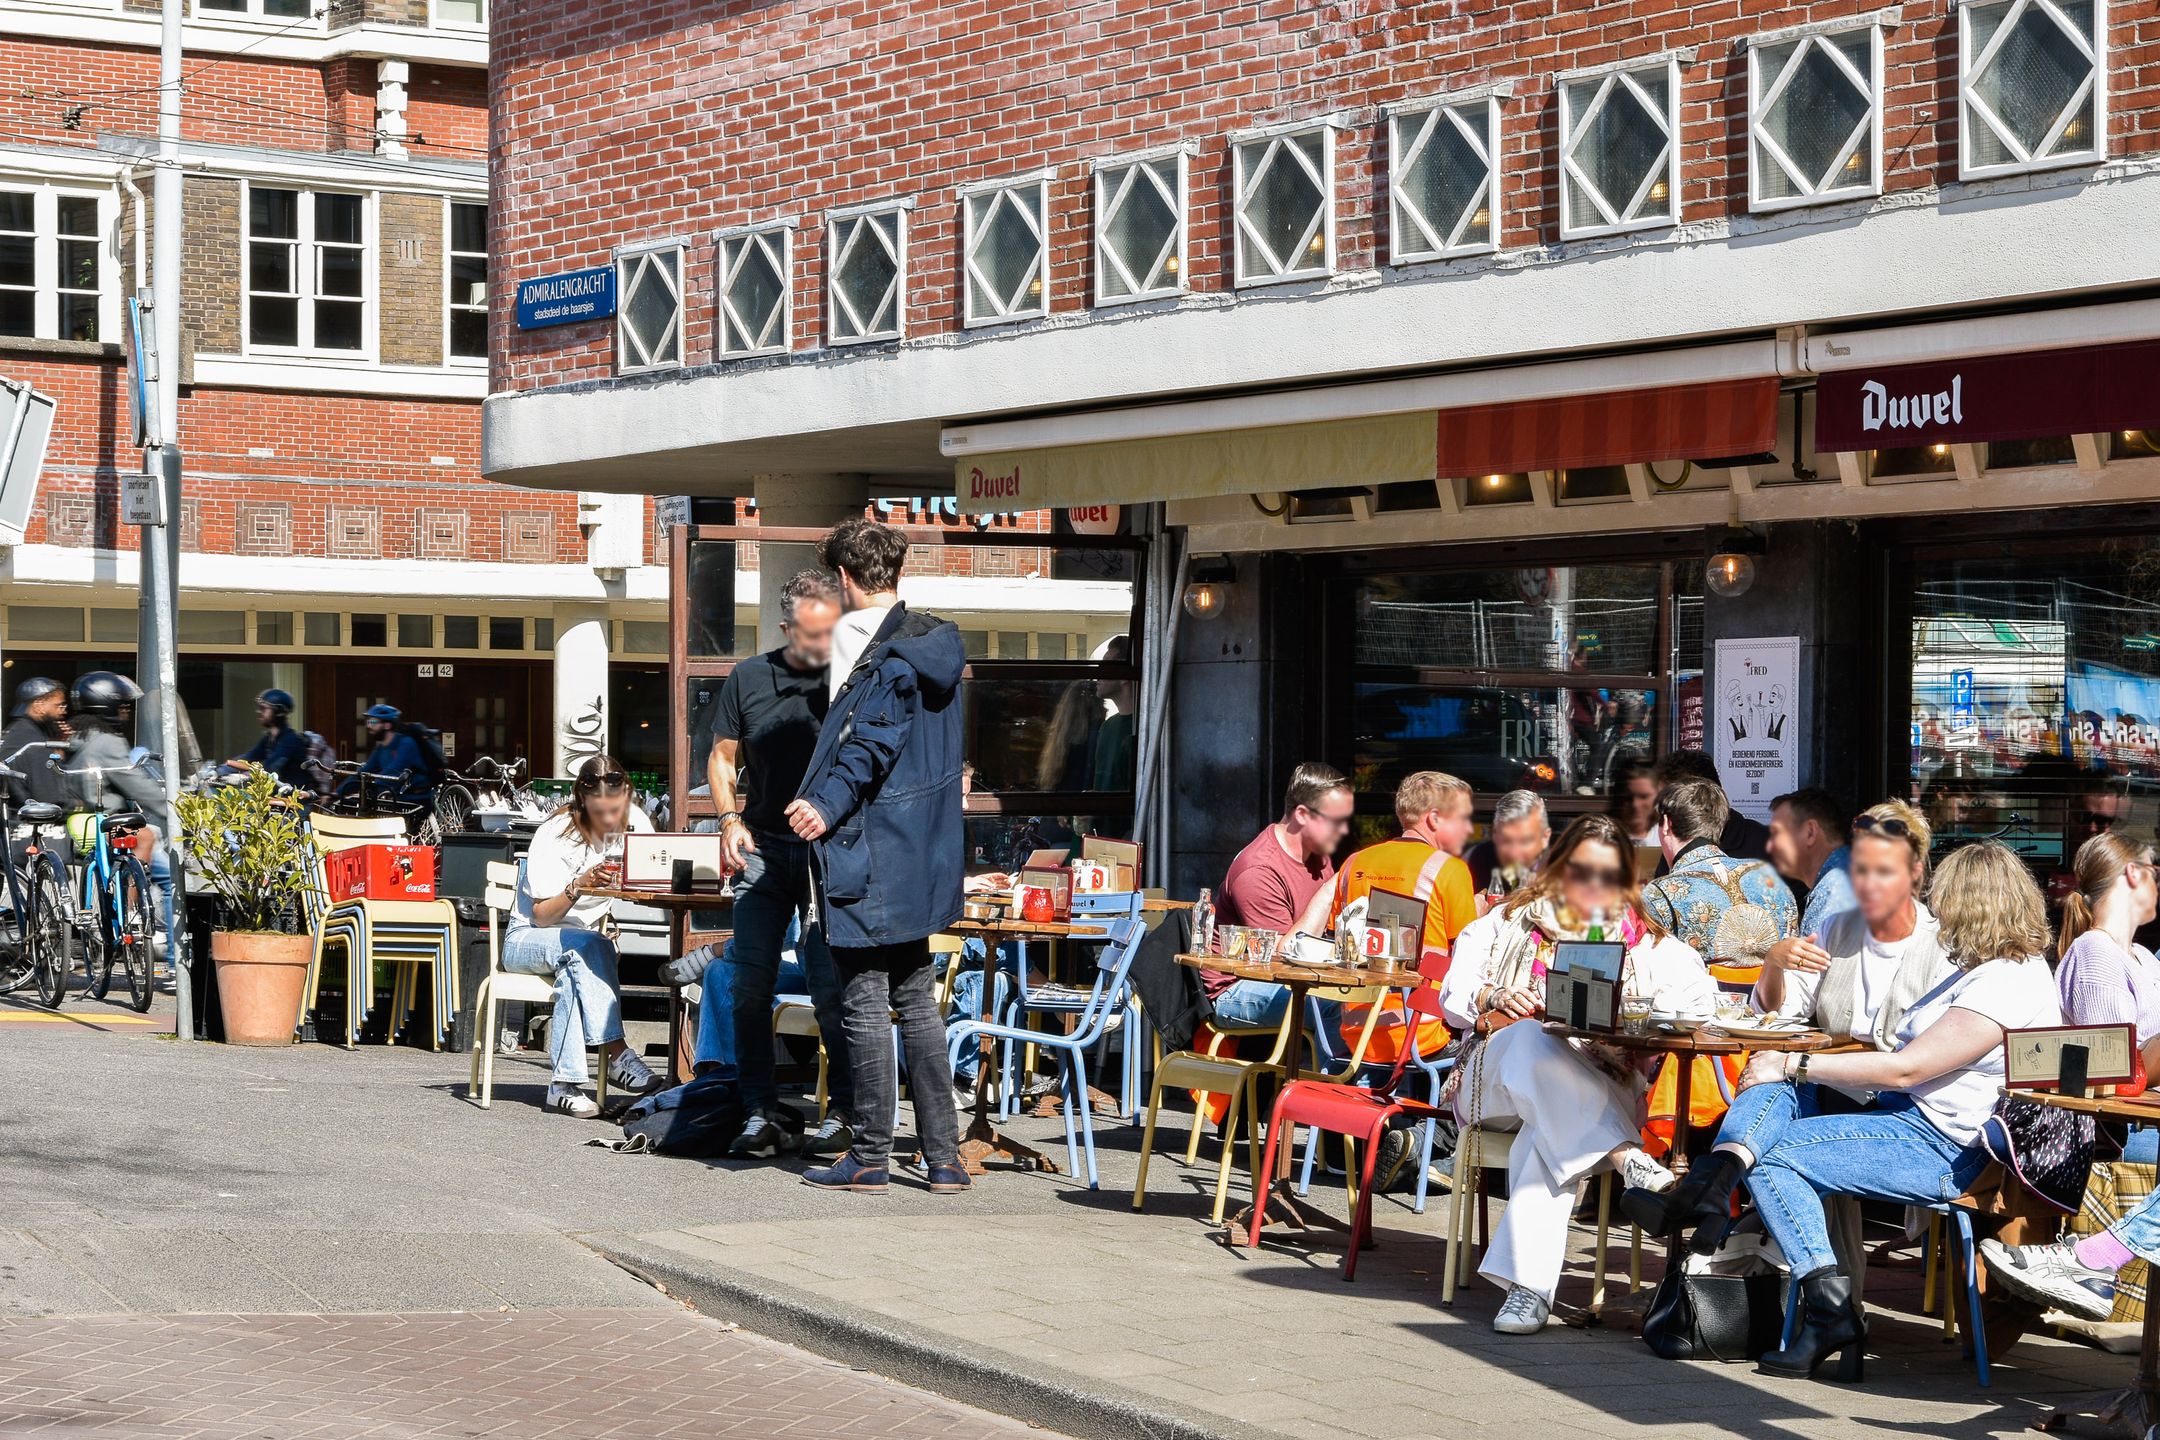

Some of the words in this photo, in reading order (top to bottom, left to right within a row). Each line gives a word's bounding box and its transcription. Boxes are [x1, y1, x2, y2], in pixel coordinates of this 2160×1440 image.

[522, 273, 607, 304] ADMIRALENGRACHT
[534, 306, 561, 320] stadsdeel
[562, 304, 570, 315] de
[570, 301, 595, 315] baarsjes
[1861, 374, 1963, 431] Duvel
[970, 465, 1020, 499] Duvel
[1070, 505, 1109, 523] uvel
[420, 666, 432, 676] 44
[440, 665, 452, 676] 42
[1750, 666, 1768, 676] FRED
[1501, 719, 1549, 758] FRE
[1732, 750, 1755, 759] BEDIENEND
[1756, 750, 1780, 759] PERSONEEL
[1735, 760, 1784, 768] KEUKENMEDEWERKERS
[1746, 770, 1765, 778] GEZOCHT
[1071, 900, 1087, 908] uvel
